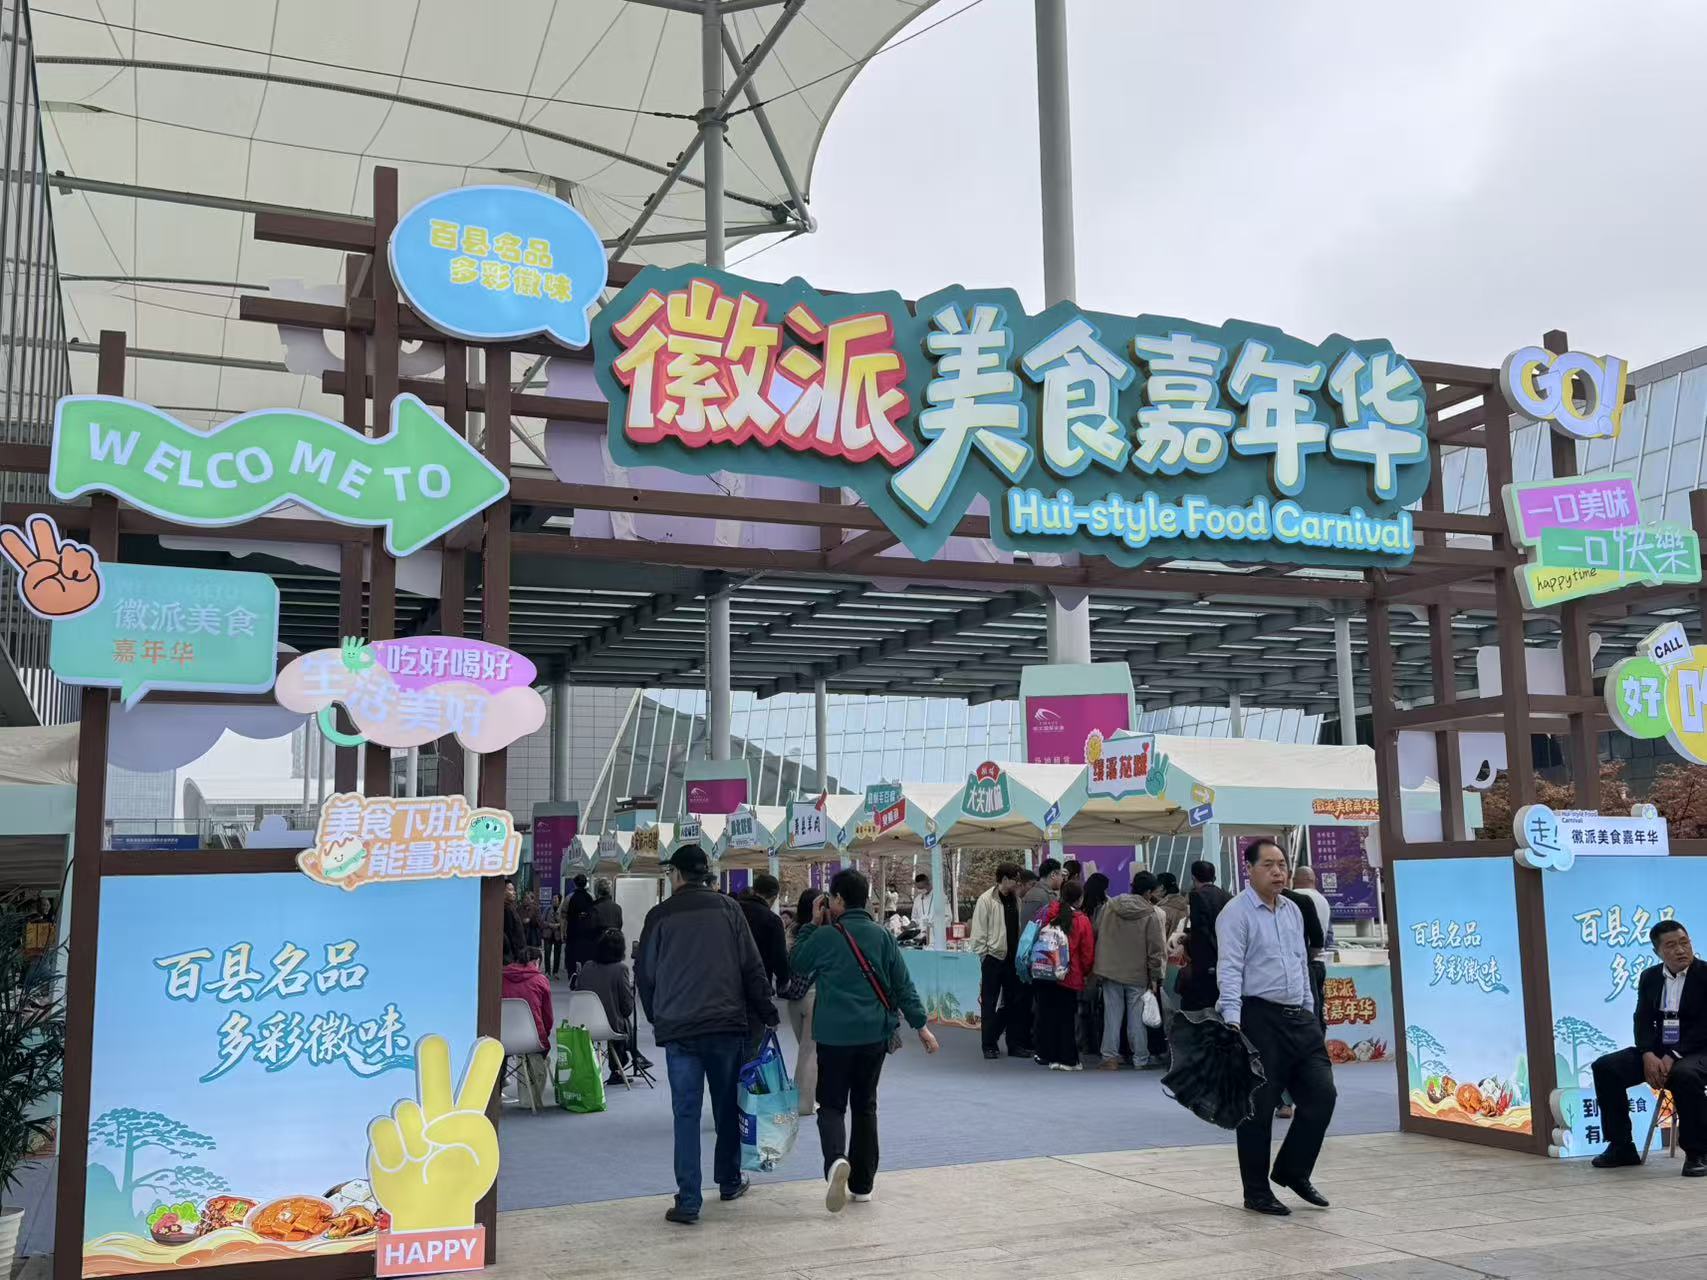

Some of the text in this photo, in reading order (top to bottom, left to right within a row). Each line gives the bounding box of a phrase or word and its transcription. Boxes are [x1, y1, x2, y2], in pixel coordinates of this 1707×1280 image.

[429, 218, 554, 268] 百县名品
[449, 255, 573, 304] 多彩徽味
[1502, 346, 1626, 438] GO!
[384, 462, 452, 502] TO
[1008, 487, 1415, 554] Hui-style Food Carnival
[1527, 487, 1630, 524] 一口美味
[112, 599, 259, 638] 徽派美食
[112, 638, 196, 668] 嘉年华
[386, 644, 513, 681] 吃好喝好
[1653, 637, 1684, 659] CALL
[302, 653, 489, 738] 生活美好
[323, 799, 467, 843] 美食下肚
[1571, 828, 1659, 845] 徽派美食嘉年华
[1409, 919, 1482, 950] 百县名品
[153, 938, 369, 1004] 百县名品
[1429, 953, 1504, 993] 多彩徽味
[199, 1003, 413, 1084] 多彩徽味
[384, 1237, 478, 1267] HAPPY
